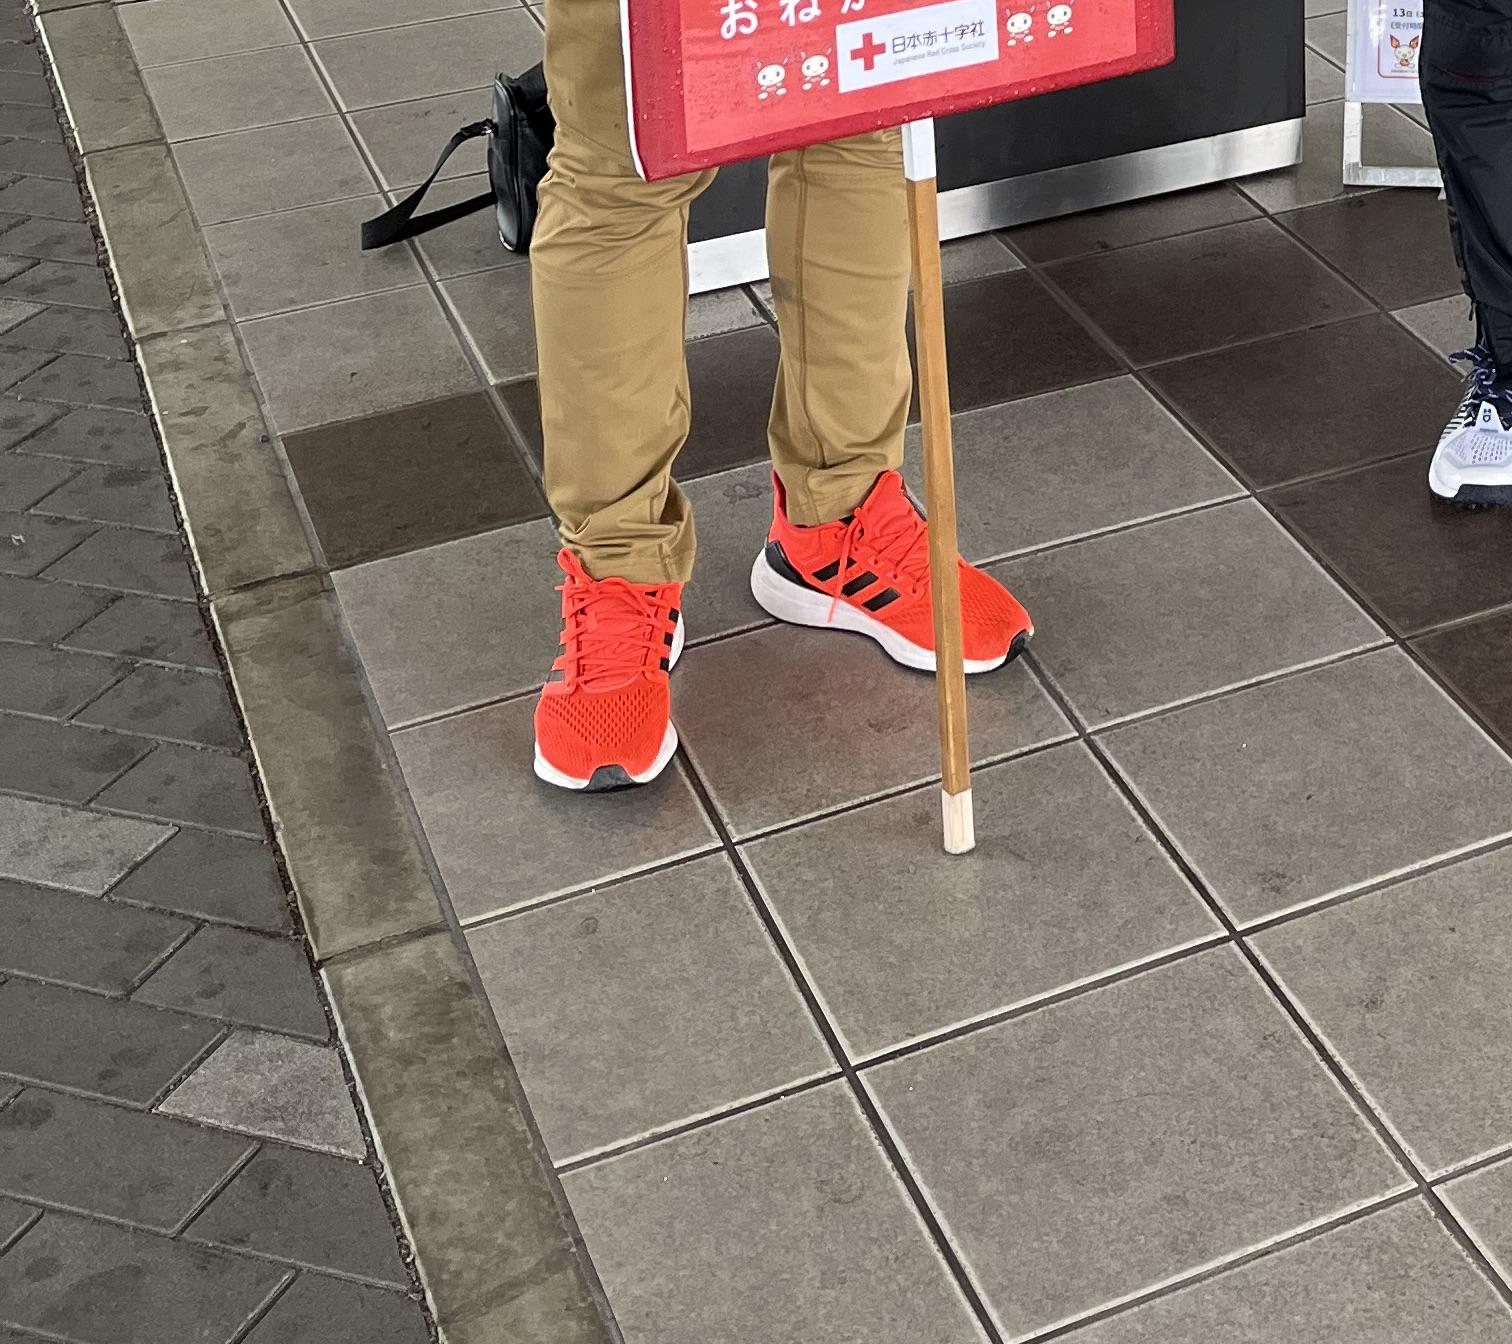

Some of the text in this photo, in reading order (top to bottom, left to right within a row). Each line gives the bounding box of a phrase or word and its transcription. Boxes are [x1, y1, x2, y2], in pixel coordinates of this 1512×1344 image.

[892, 19, 985, 54] 日本赤十字社
